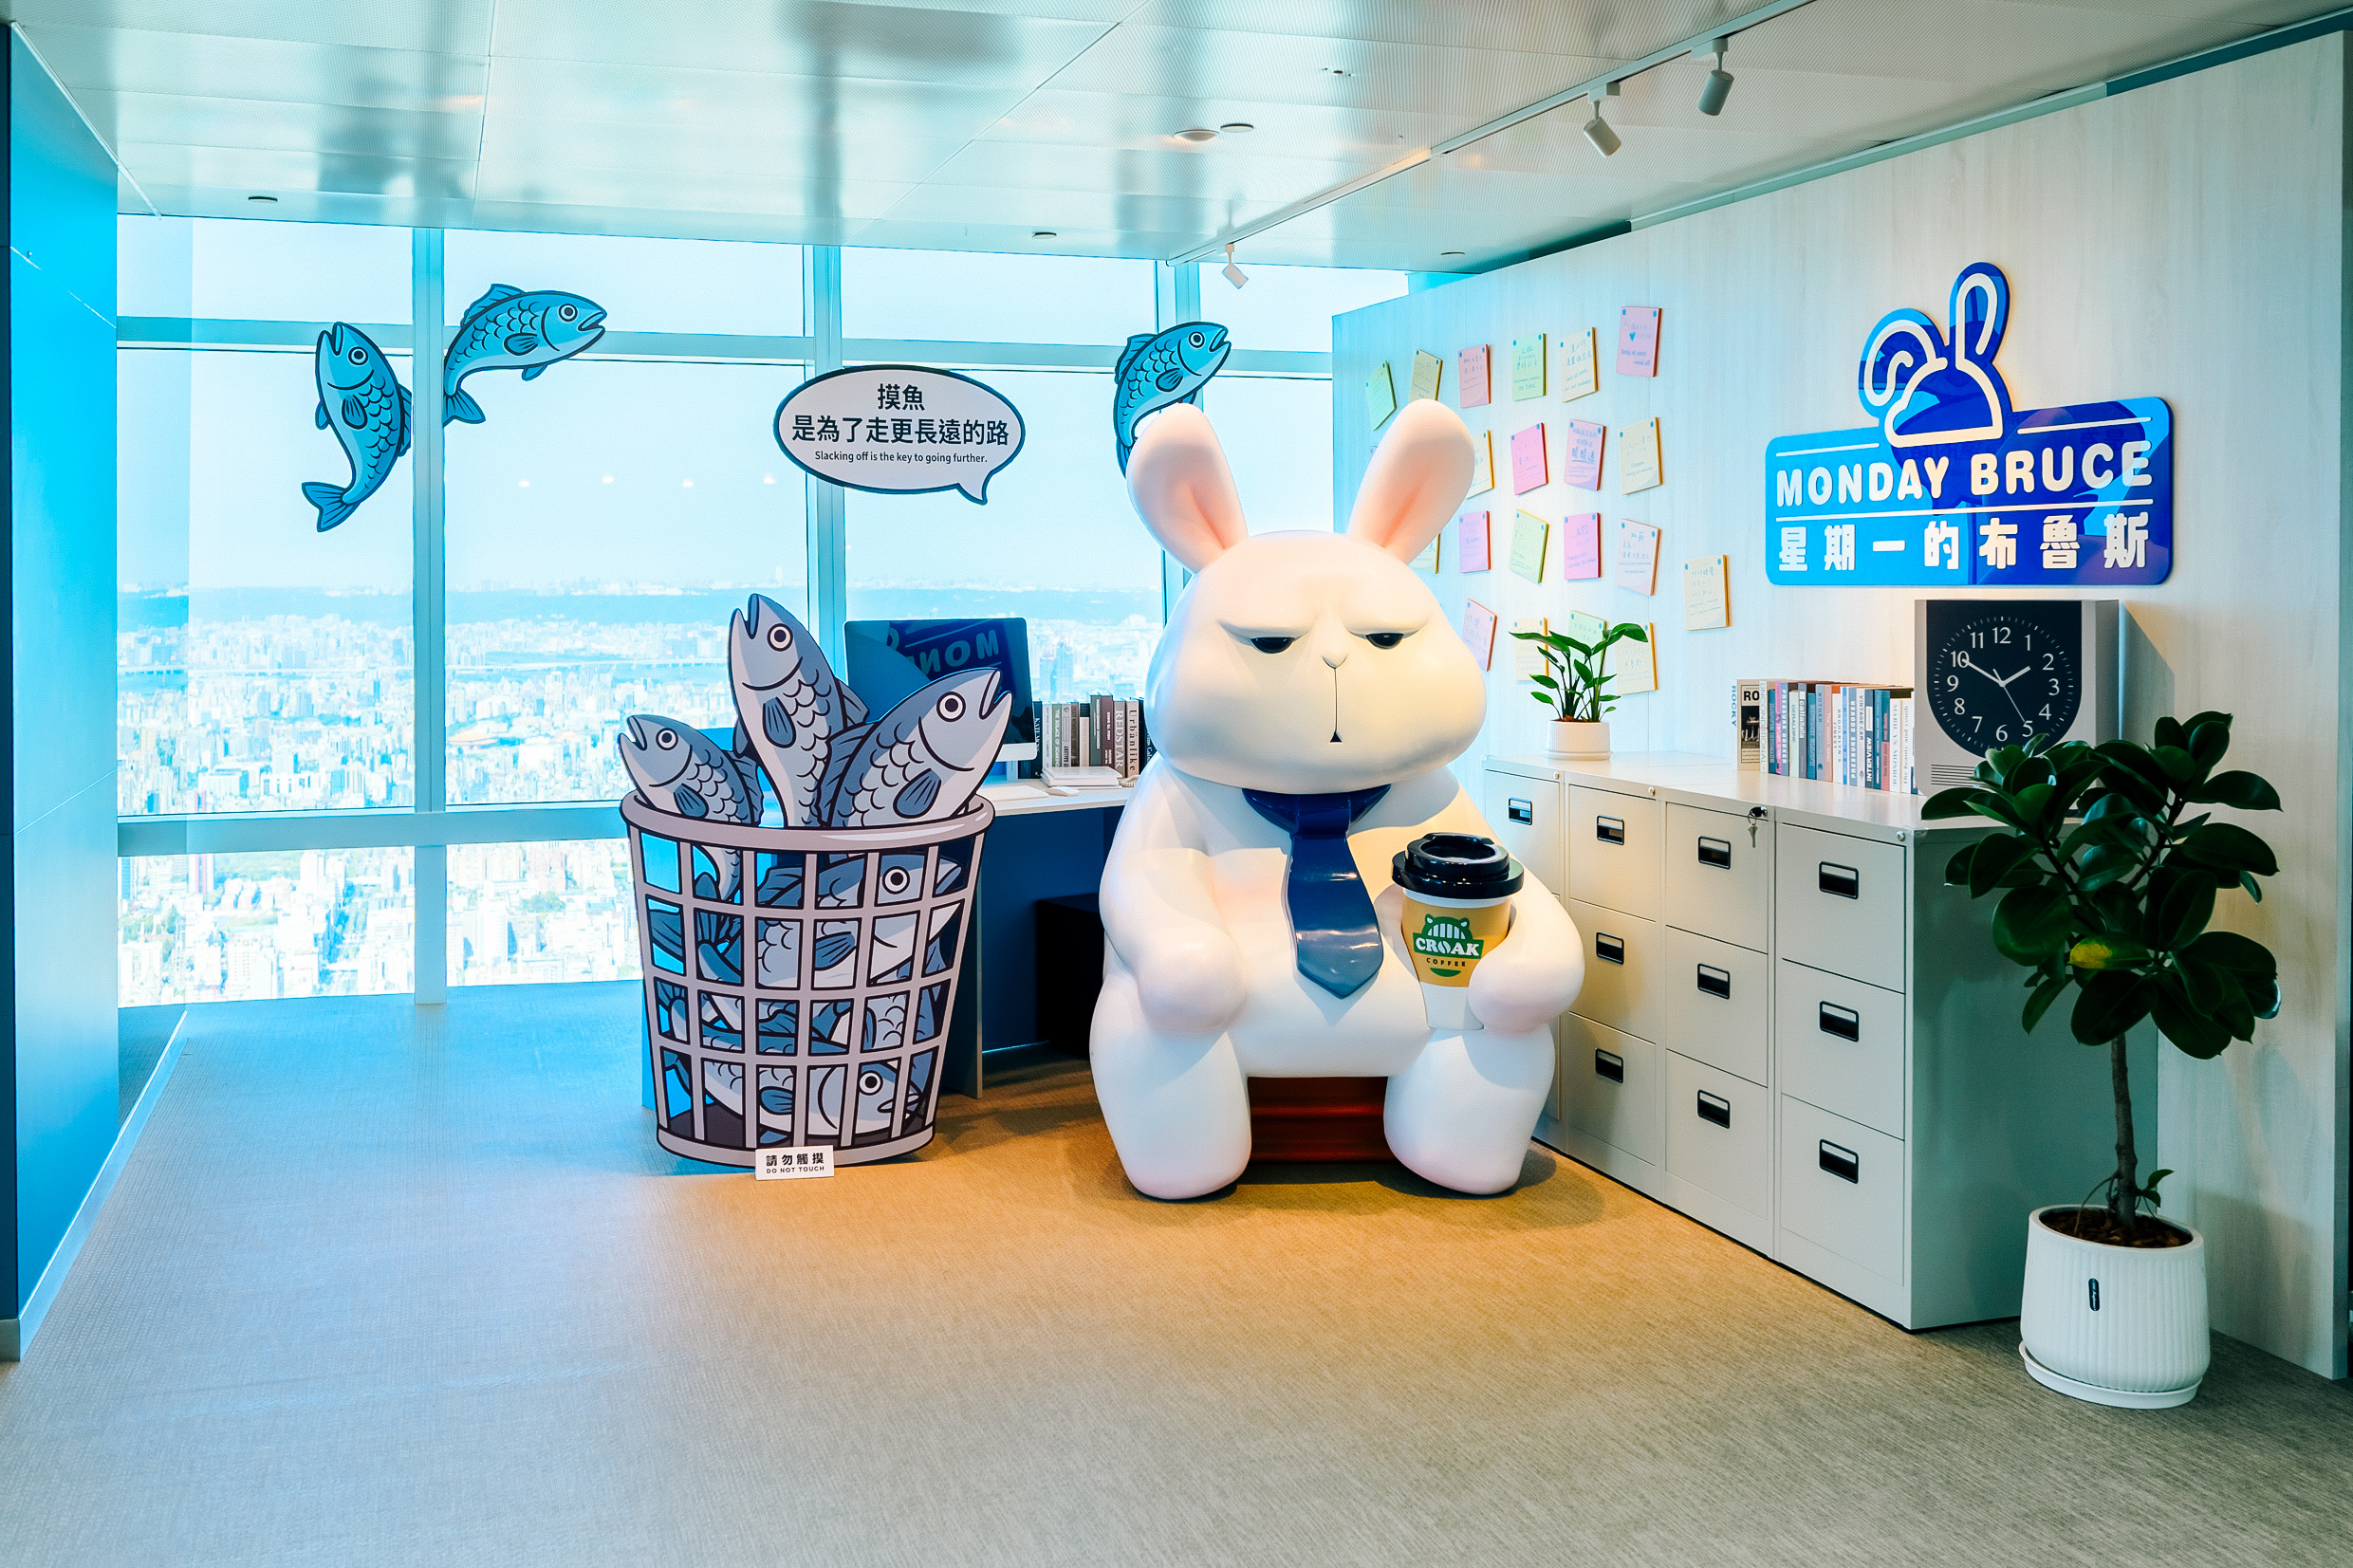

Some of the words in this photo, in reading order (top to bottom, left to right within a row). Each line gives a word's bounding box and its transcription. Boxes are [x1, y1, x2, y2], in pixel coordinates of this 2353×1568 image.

[878, 383, 925, 411] 摸魚
[792, 415, 1009, 446] 是為了走更長遠的路
[815, 451, 854, 463] Slacking
[856, 451, 869, 462] off
[870, 452, 878, 462] is
[880, 452, 895, 462] the
[897, 452, 913, 465] key
[914, 453, 923, 463] to
[925, 453, 951, 465] going
[953, 452, 988, 464] further.
[1776, 456, 1950, 507] MONDAY
[1971, 440, 2154, 496] BRUCE
[1778, 511, 2150, 572] 星期一的布魯斯
[1970, 632, 1984, 649] 11
[1992, 626, 2011, 644] 12
[2025, 634, 2031, 652] 1
[1951, 650, 1970, 669] 10
[2042, 653, 2054, 671] 2
[1946, 674, 1959, 692] 9
[2047, 678, 2060, 696] 3
[1955, 697, 1966, 715] 8
[2038, 703, 2052, 721] 4
[1972, 716, 1983, 733] 7
[1995, 724, 2009, 742] 6
[2022, 720, 2034, 738] 5
[1115, 710, 1124, 768] REDSTAR
[1129, 710, 1138, 771] Urbänlike
[1416, 937, 1479, 956] CROAK
[1426, 957, 1466, 967] COFFEE
[766, 1153, 824, 1167] 請勿觸摸
